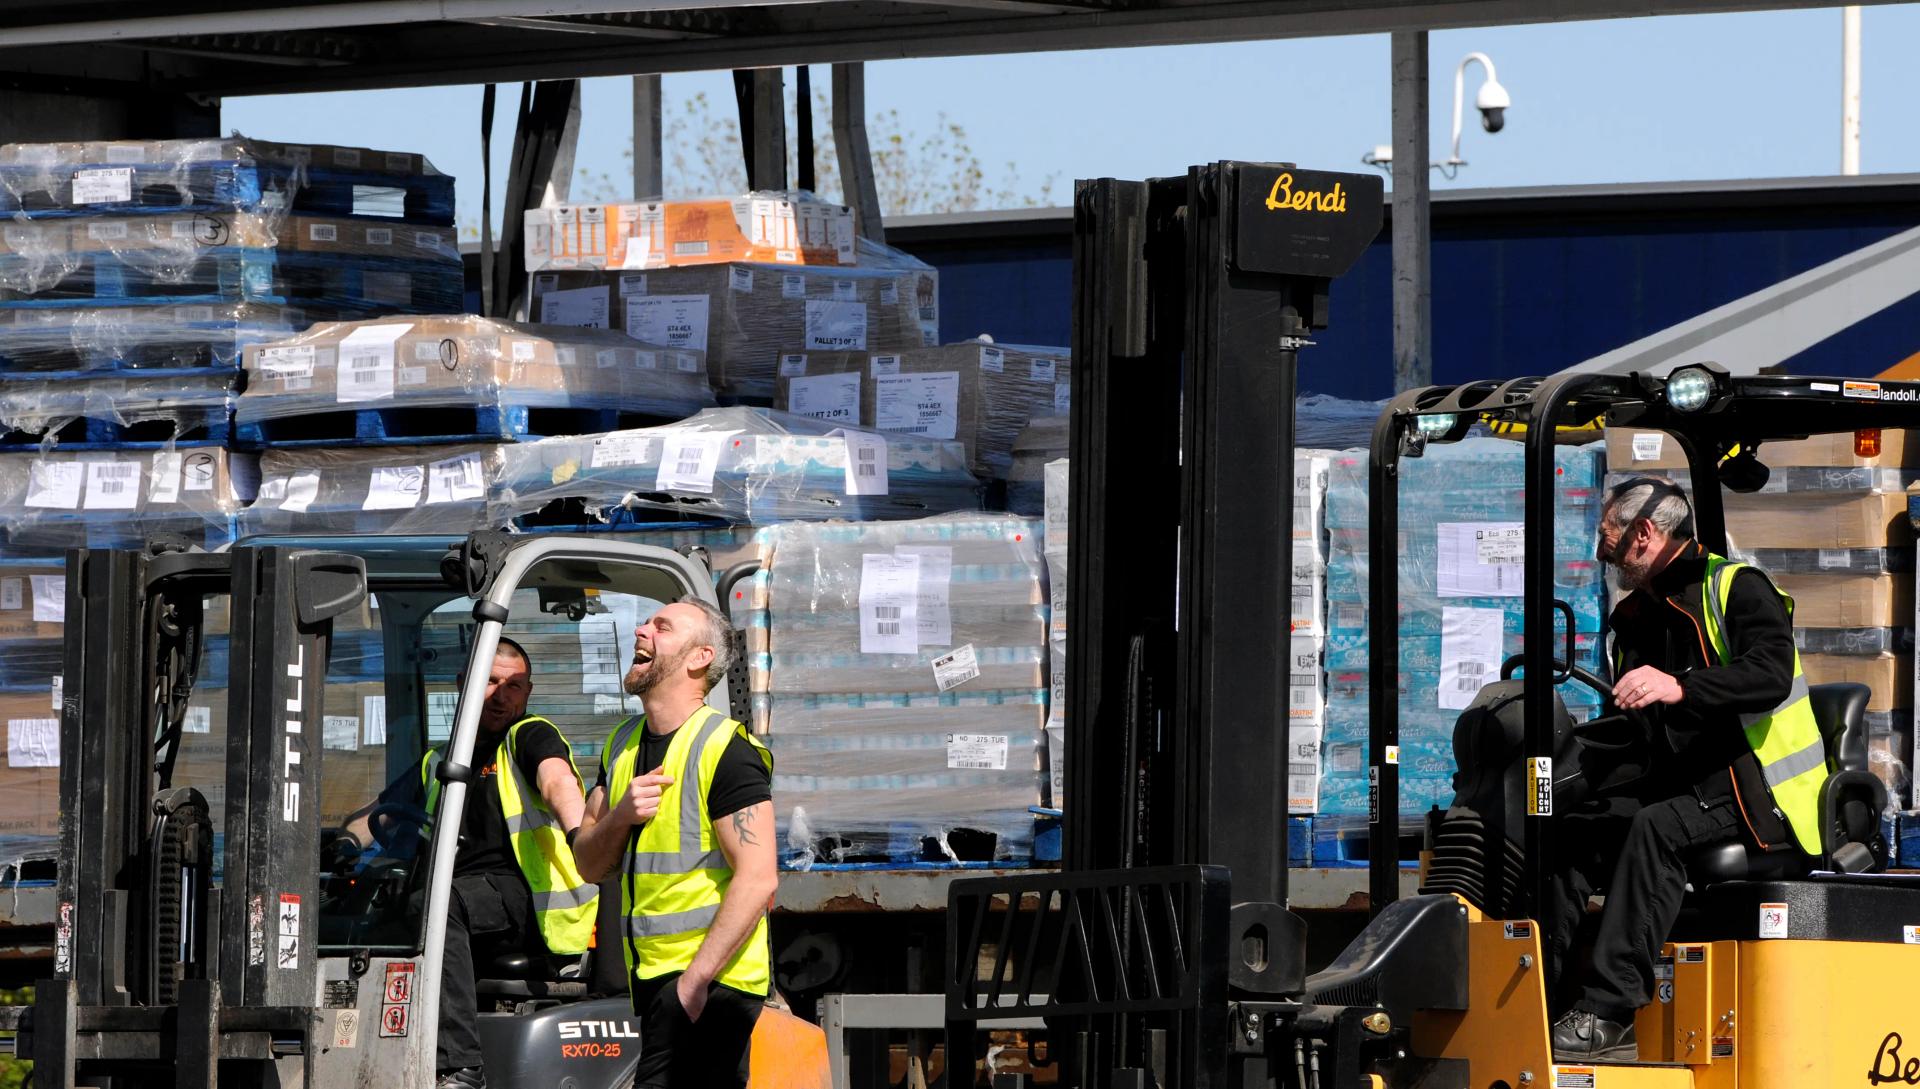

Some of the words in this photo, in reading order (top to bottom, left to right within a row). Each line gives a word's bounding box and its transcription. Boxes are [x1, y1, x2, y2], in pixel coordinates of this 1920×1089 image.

[1265, 173, 1346, 212] Bendi
[814, 337, 837, 345] PALLET
[1880, 388, 1920, 401] landoll.
[832, 409, 842, 417] OF
[1506, 529, 1519, 537] 275
[345, 719, 356, 727] TUE
[284, 644, 303, 823] STILL
[991, 736, 1005, 744] TUE
[558, 1021, 640, 1039] STILL
[561, 1043, 621, 1058] RX70-25
